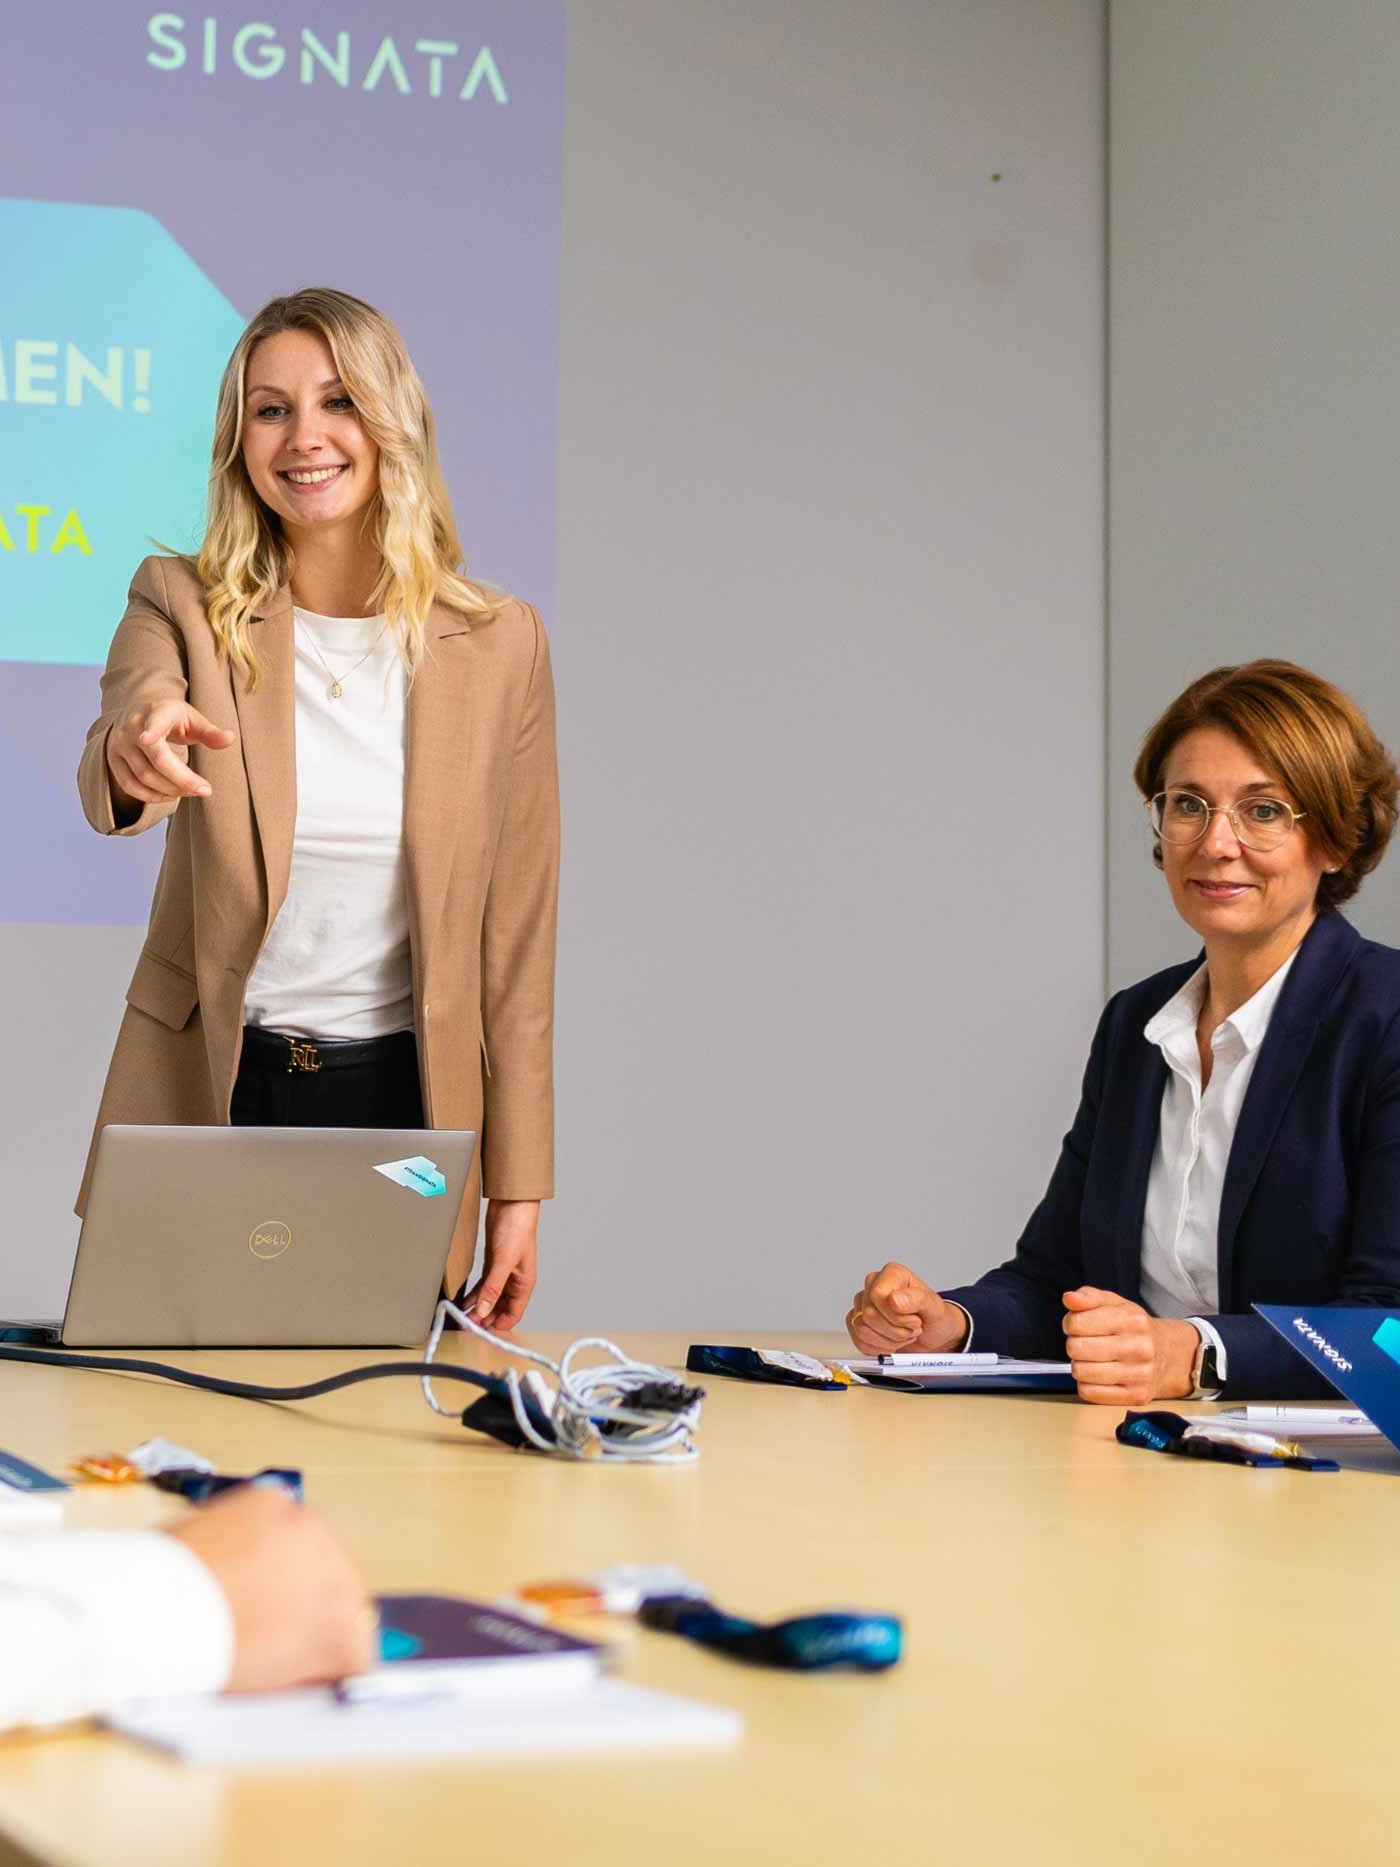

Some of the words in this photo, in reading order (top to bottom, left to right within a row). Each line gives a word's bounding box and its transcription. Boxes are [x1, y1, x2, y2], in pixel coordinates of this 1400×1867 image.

[146, 12, 509, 105] SIGNATA
[255, 1234, 286, 1245] DELL
[1292, 1317, 1353, 1373] SIGNATA
